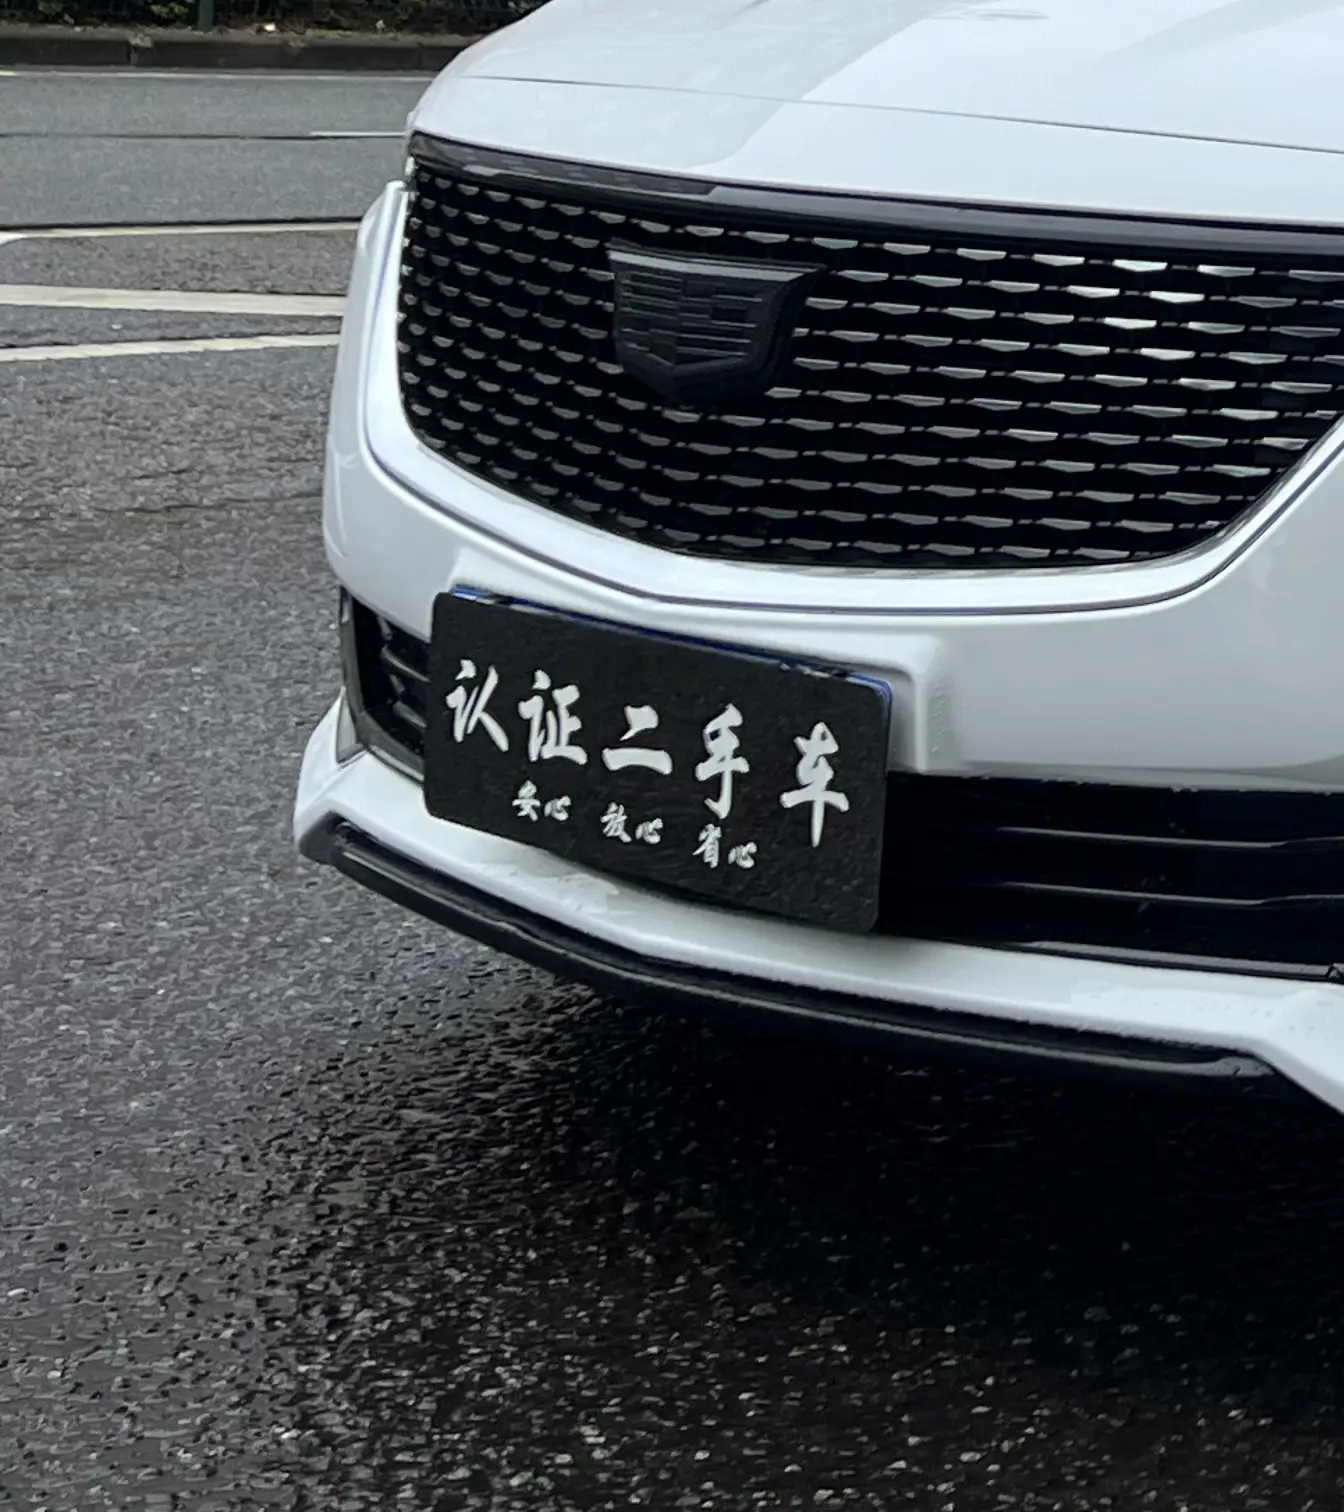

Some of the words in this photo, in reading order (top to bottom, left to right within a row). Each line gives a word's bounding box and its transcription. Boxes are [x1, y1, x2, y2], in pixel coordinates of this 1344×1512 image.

[445, 659, 850, 848] 认证二手车
[512, 779, 571, 823] 安心
[600, 801, 663, 844] 放心
[692, 822, 758, 869] 省心
